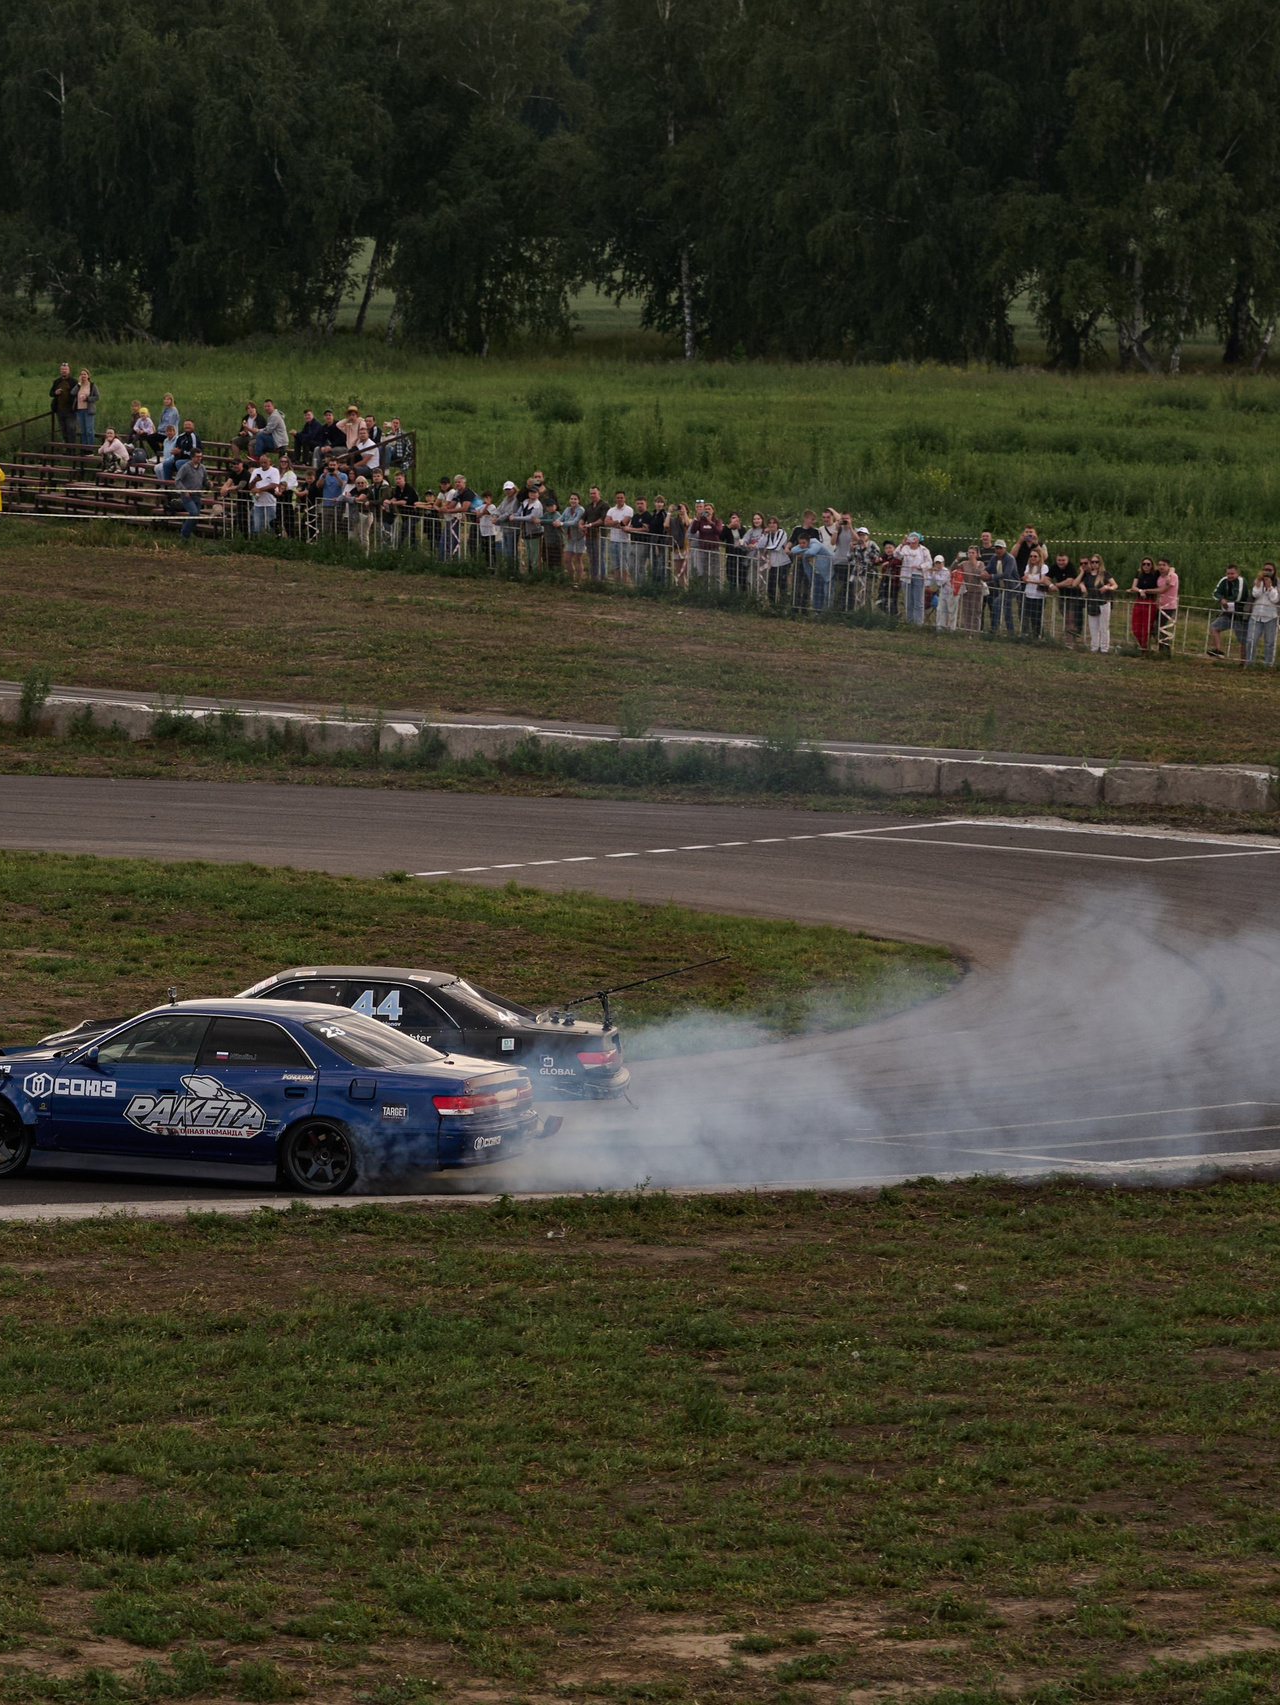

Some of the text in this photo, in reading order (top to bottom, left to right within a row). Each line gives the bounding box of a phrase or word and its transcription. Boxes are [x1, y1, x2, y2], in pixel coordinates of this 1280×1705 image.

[350, 989, 403, 1021] 44
[320, 1026, 347, 1039] 23
[540, 1068, 577, 1076] GLOBAL
[54, 1078, 117, 1098] СОЮЗ
[125, 1096, 263, 1130] РАКЕТА
[382, 1106, 408, 1117] TARGET
[206, 1128, 243, 1137] КОМАНДА
